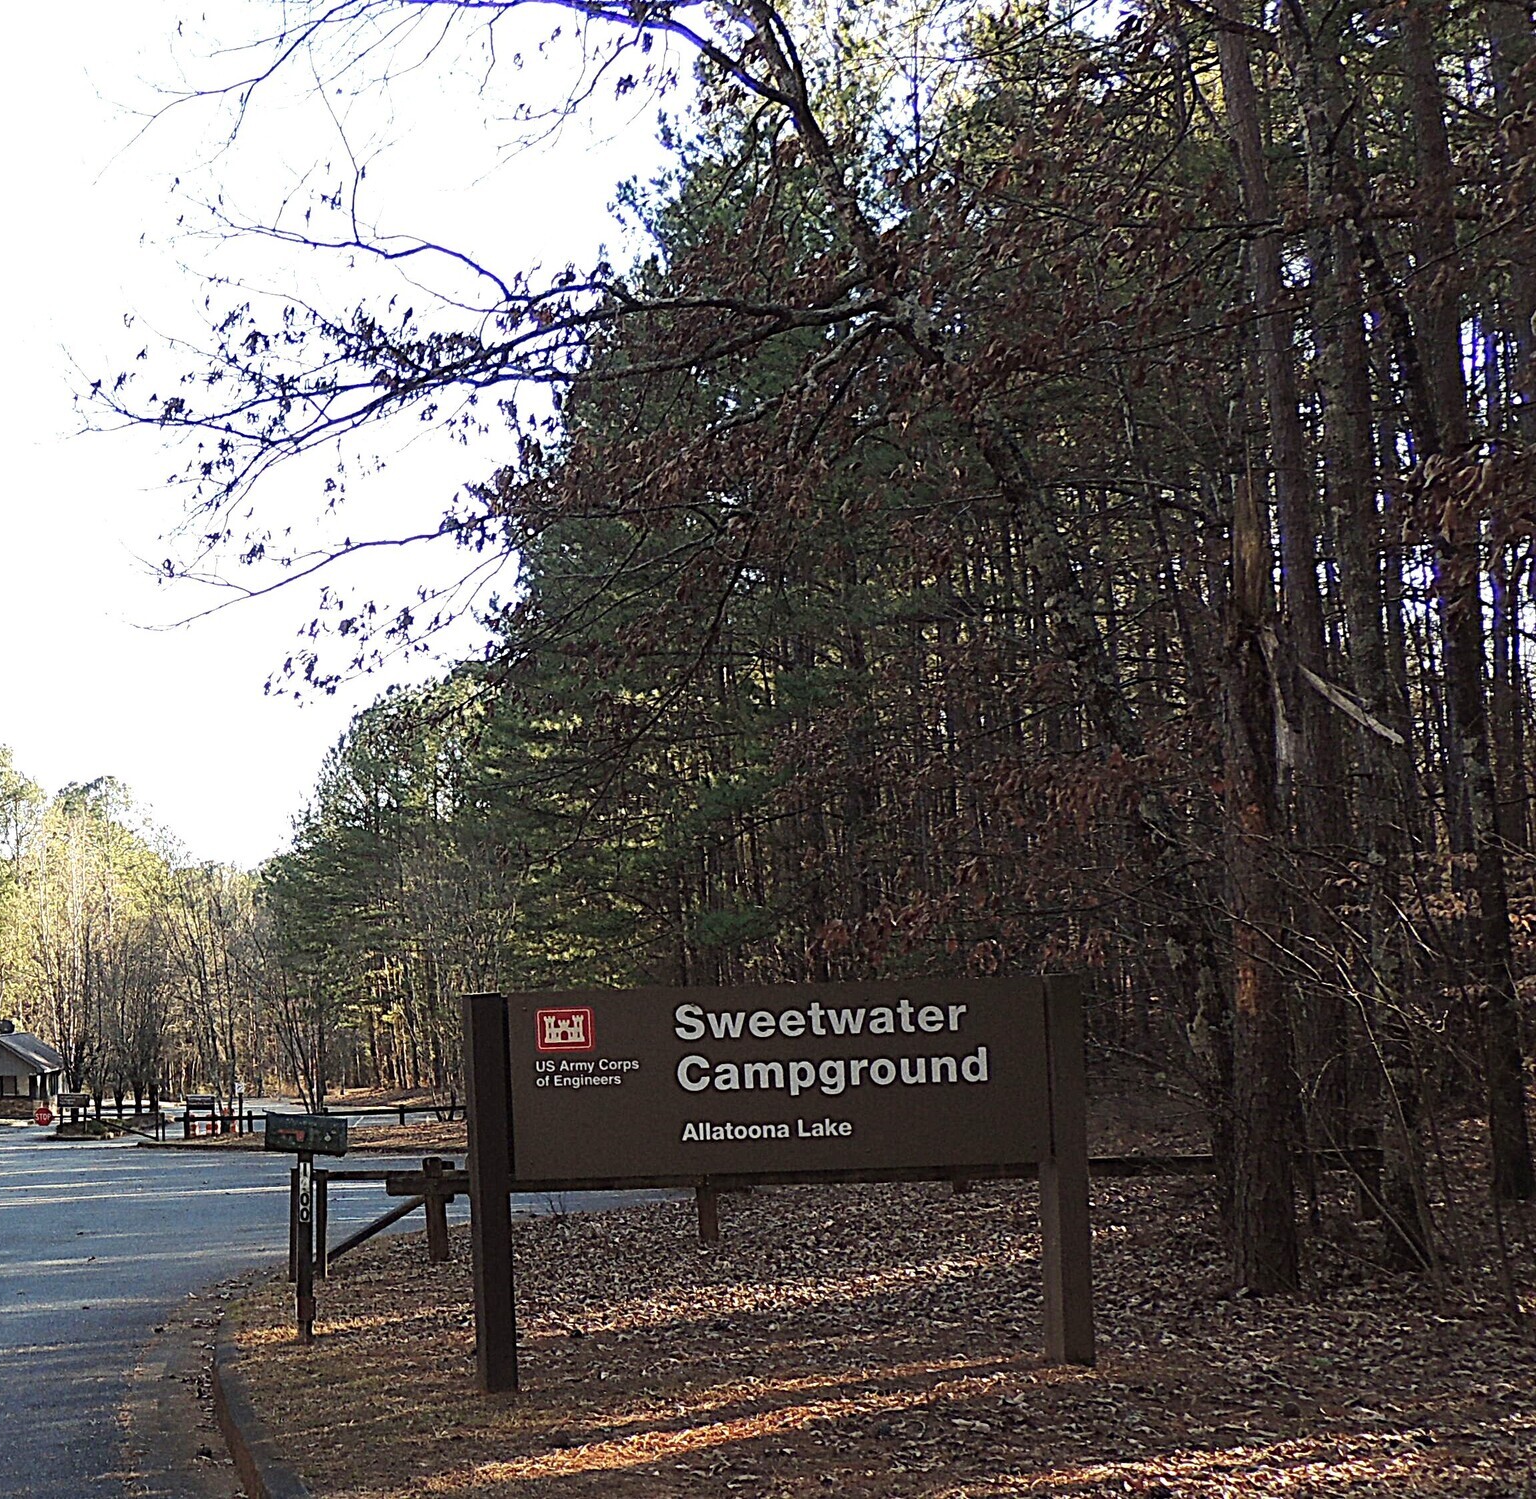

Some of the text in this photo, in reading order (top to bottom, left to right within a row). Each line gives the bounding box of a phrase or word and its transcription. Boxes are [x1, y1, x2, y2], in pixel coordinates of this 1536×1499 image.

[674, 999, 967, 1041] Sweetwater
[535, 1058, 640, 1073] US Army Corps
[676, 1046, 989, 1096] Campground
[535, 1074, 622, 1089] of Engineers
[35, 1113, 52, 1121] STOP
[681, 1118, 853, 1141] Allatoona Lake
